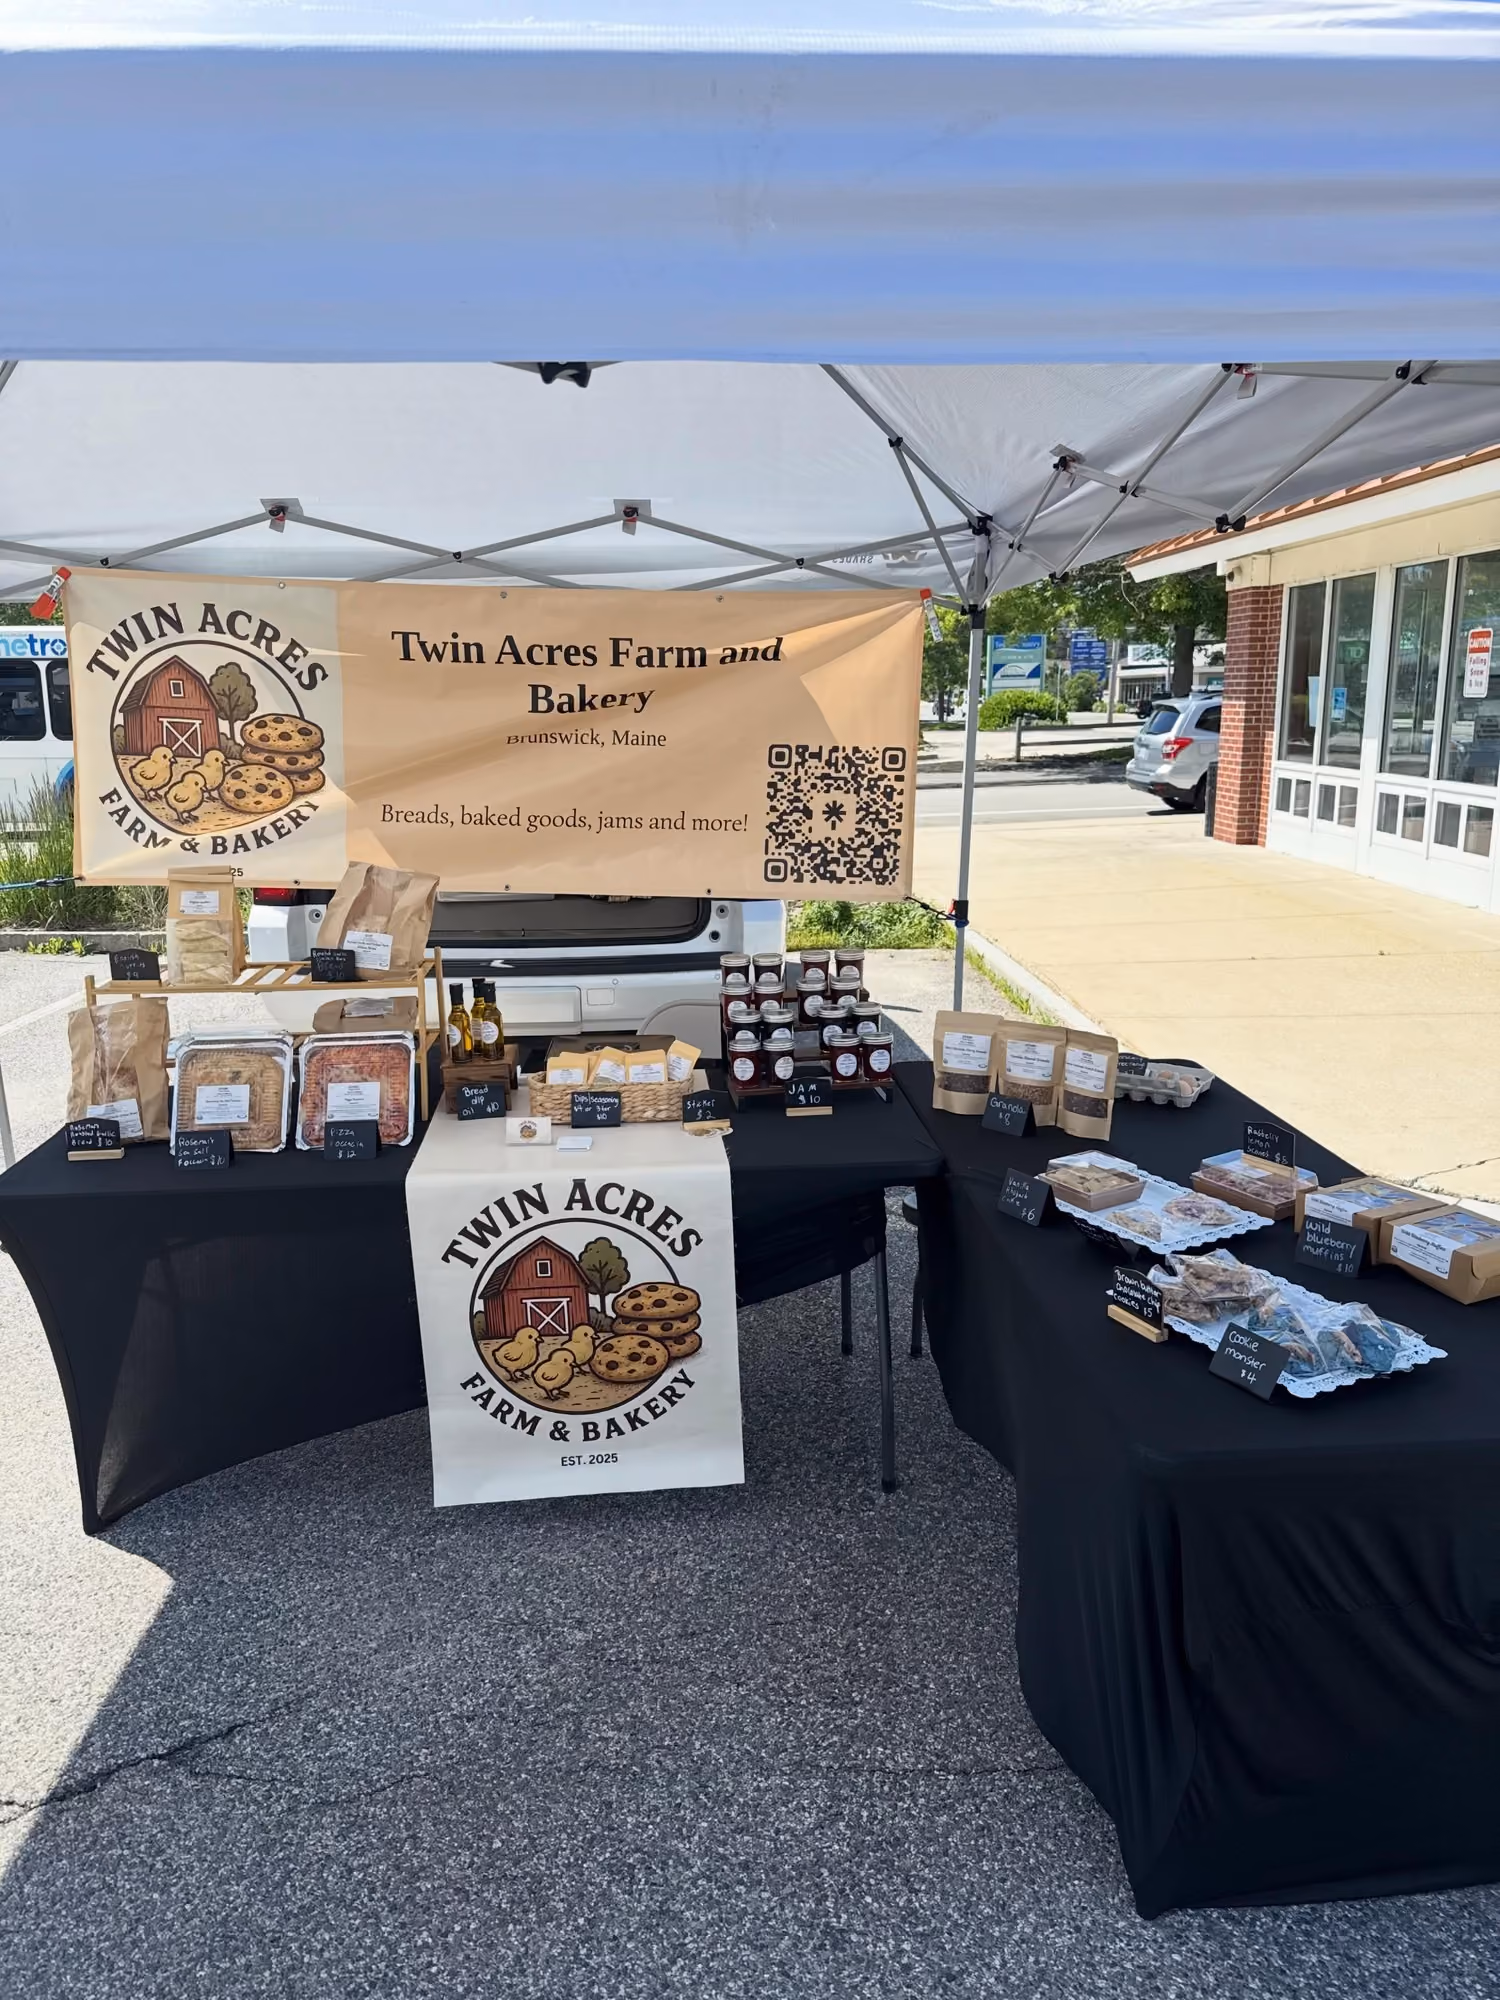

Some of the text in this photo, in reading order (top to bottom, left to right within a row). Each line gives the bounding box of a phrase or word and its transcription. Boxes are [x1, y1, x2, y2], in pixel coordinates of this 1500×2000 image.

[86, 602, 328, 691] TWIN ACRES
[391, 631, 784, 669] Twin Acres Farm and
[528, 684, 655, 714] Bakery
[506, 729, 667, 748] Brunswick, Maine
[99, 787, 320, 855] FARM & BAKERY
[380, 803, 748, 834] Breads, baked goods, jams and more!
[462, 1084, 488, 1097] Bread
[788, 1083, 818, 1095] JAM
[441, 1178, 703, 1269] TWIN ACRES
[1302, 1244, 1345, 1261] muffins
[1306, 1231, 1357, 1259] blueberry
[1224, 1347, 1266, 1371] monster
[459, 1368, 696, 1442] FARM & BAKERY
[560, 1452, 618, 1467] EST. 2025
